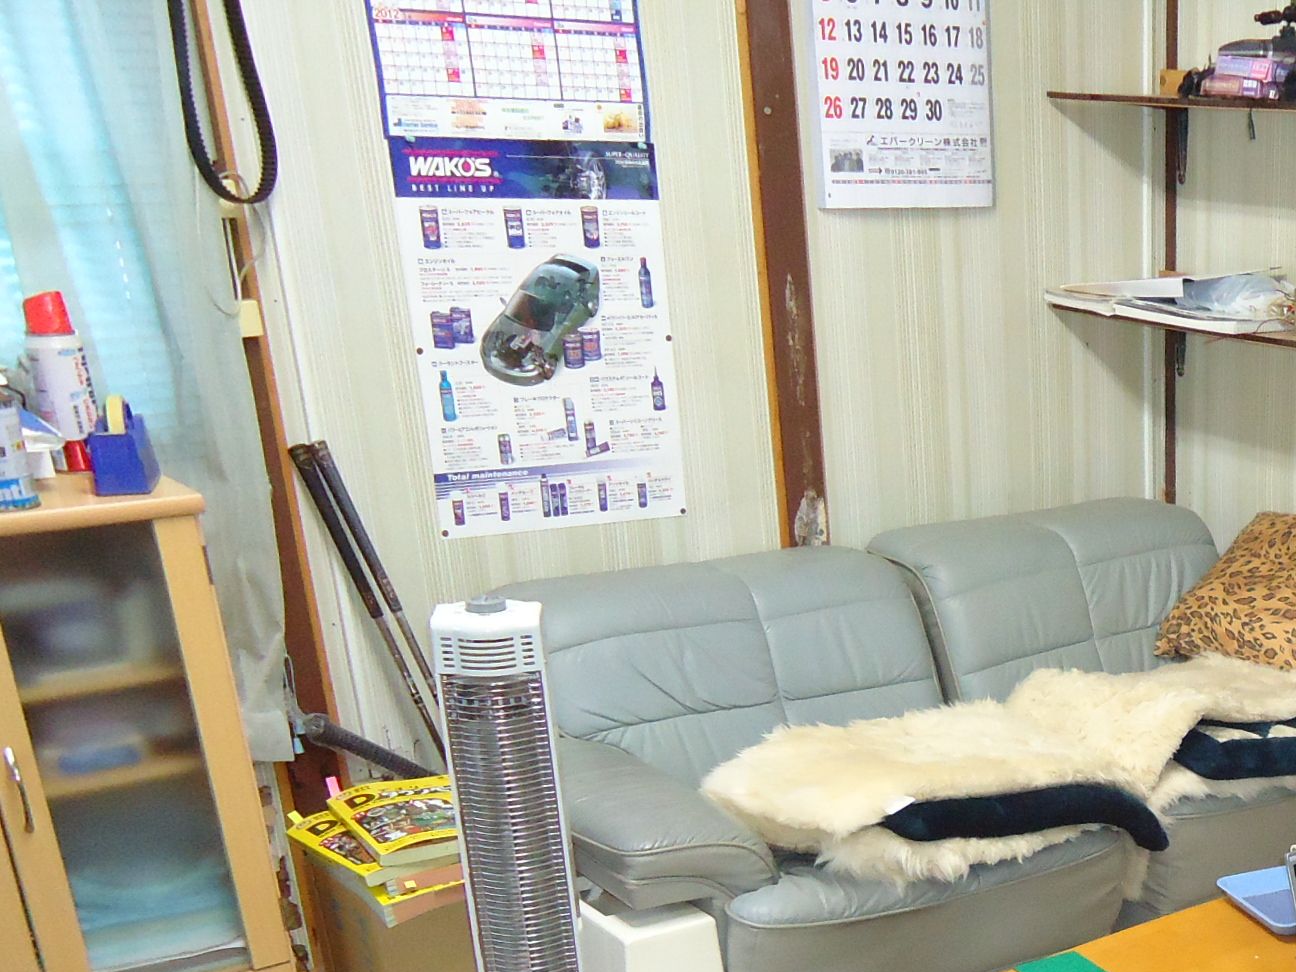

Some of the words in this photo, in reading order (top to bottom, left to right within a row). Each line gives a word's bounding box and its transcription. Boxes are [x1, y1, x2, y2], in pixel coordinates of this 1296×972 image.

[375, 8, 400, 19] 2012
[819, 18, 836, 41] 12
[845, 19, 862, 42] 13
[871, 20, 888, 43] 14
[896, 22, 913, 45] 15
[921, 24, 937, 47] 16
[945, 25, 960, 47] 17
[969, 26, 983, 49] 18
[822, 57, 840, 80] 19
[847, 57, 865, 81] 20
[873, 59, 889, 82] 21
[898, 60, 915, 83] 22
[923, 61, 940, 84] 23
[947, 63, 963, 85] 24
[970, 64, 985, 86] 25
[824, 95, 843, 119] 26
[851, 96, 867, 119] 27
[875, 97, 893, 120] 28
[901, 98, 918, 120] 29
[926, 99, 942, 121] 30
[411, 183, 439, 192] BEST
[447, 184, 473, 193] LINE
[480, 184, 494, 193] UP
[447, 472, 470, 482] Total
[472, 469, 529, 480] maintenance
